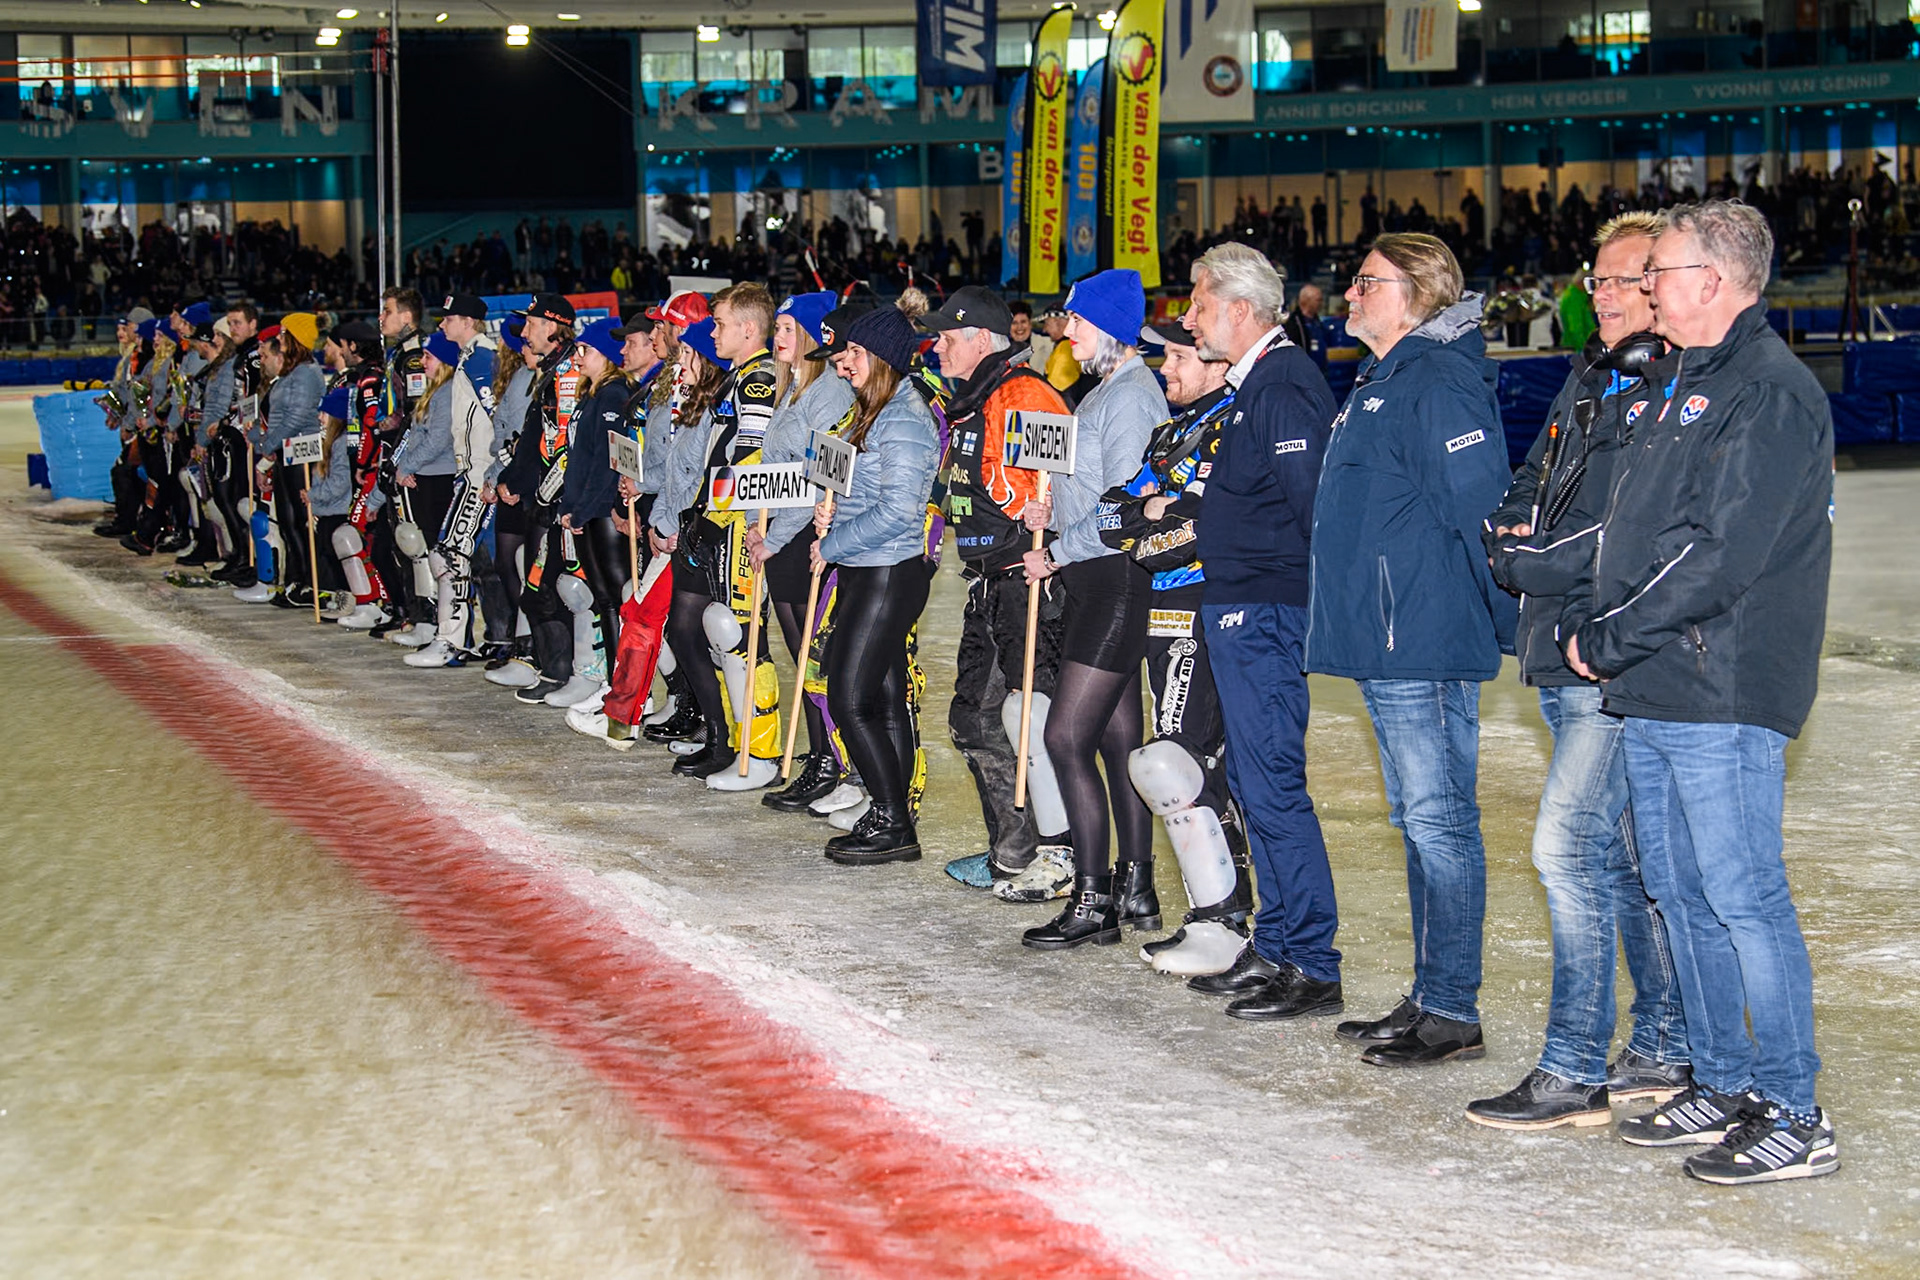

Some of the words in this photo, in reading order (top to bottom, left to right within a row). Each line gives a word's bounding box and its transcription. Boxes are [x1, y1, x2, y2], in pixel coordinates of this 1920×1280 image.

[1692, 79, 1773, 99] YVONNE
[1779, 78, 1816, 94] VAN
[1821, 73, 1890, 92] GENNIP
[1134, 91, 1150, 136] van
[1265, 103, 1320, 120] ANNIE
[1491, 93, 1535, 109] HEIN
[1047, 108, 1058, 150] van
[1045, 158, 1060, 199] der
[1132, 145, 1151, 188] der
[1039, 207, 1059, 263] Vegt
[1127, 196, 1152, 255] Vegt
[1024, 422, 1069, 461] SWEDEN
[1276, 441, 1304, 451] MOTUL
[1450, 432, 1482, 449] MOTUL
[816, 443, 849, 484] FINLAND
[737, 472, 809, 501] GERMANY
[980, 535, 994, 546] OY
[1218, 610, 1245, 630] FIM
[1181, 659, 1192, 678] AB
